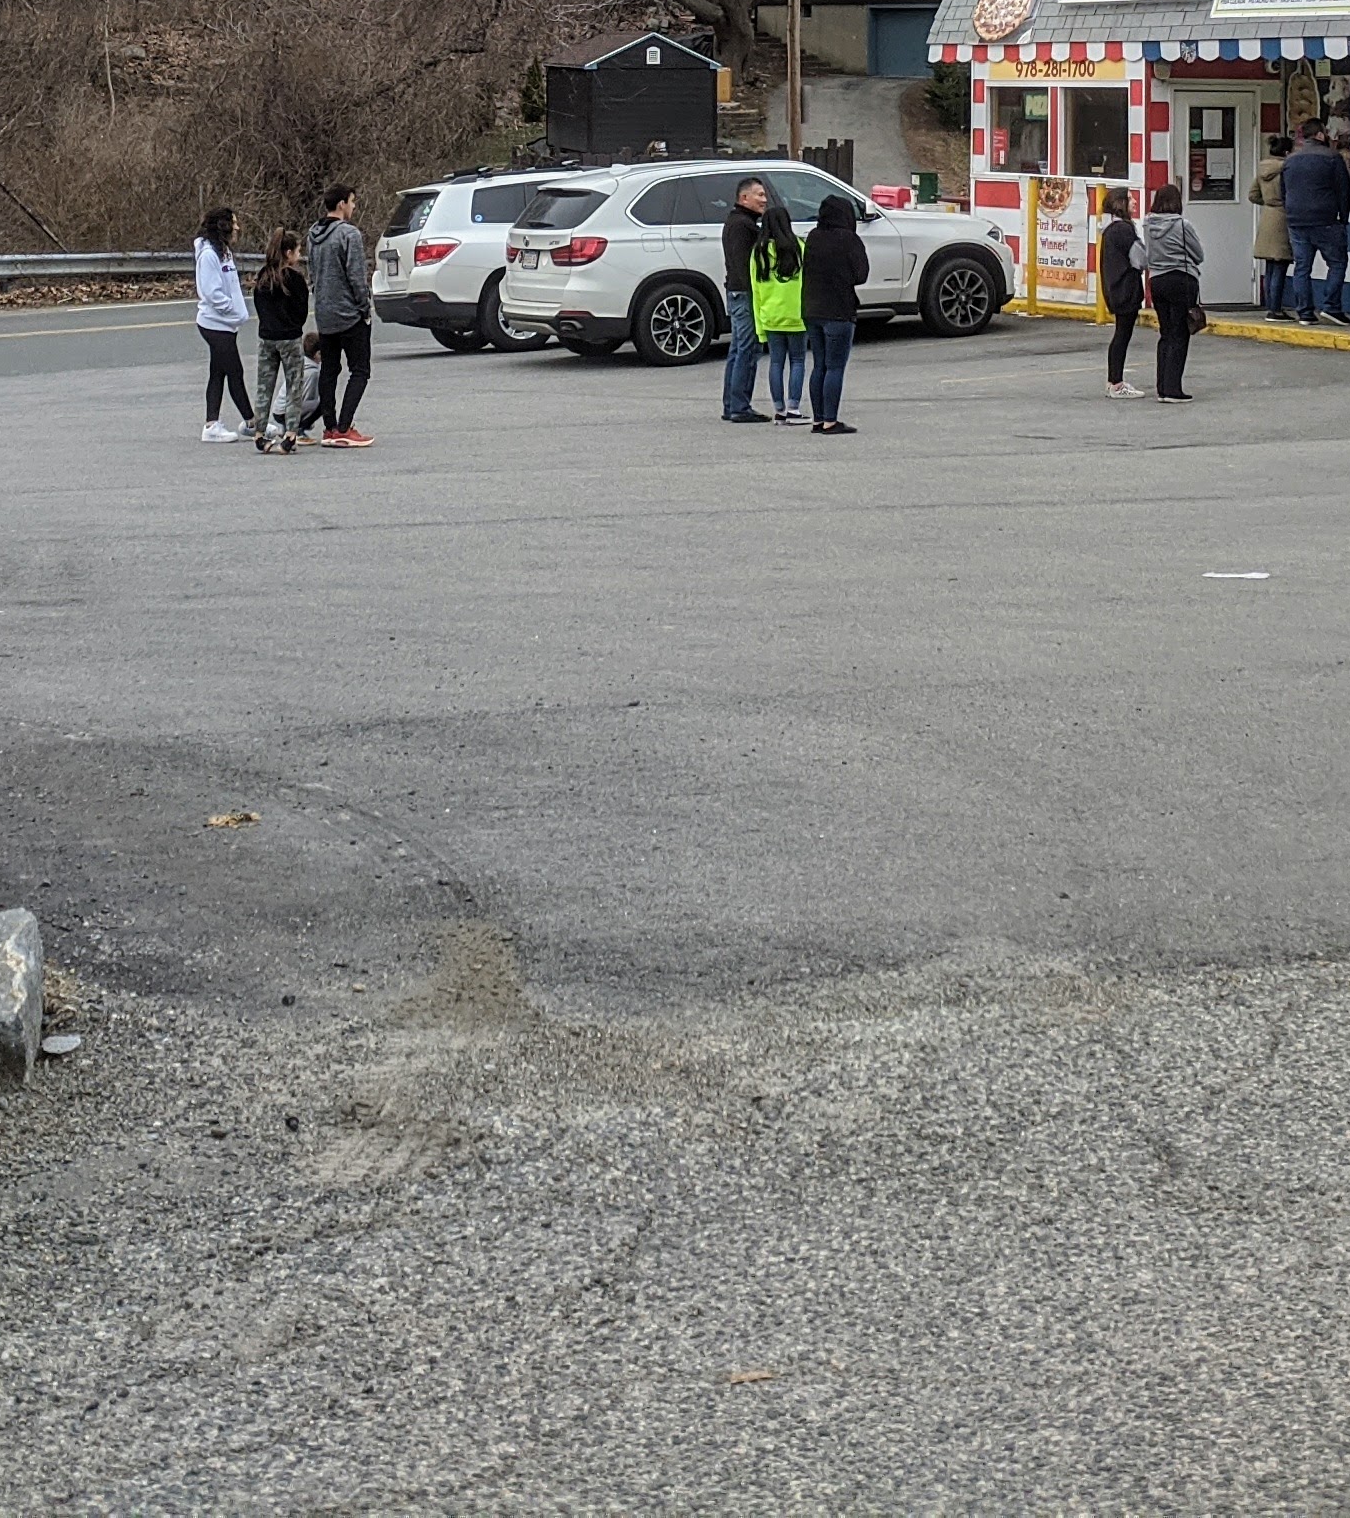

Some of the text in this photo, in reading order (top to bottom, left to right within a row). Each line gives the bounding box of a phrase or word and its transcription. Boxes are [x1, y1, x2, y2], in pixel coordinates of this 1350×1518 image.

[1015, 60, 1096, 78] 978-281-1700
[1051, 219, 1073, 232] Place
[1040, 237, 1068, 251] Winner!
